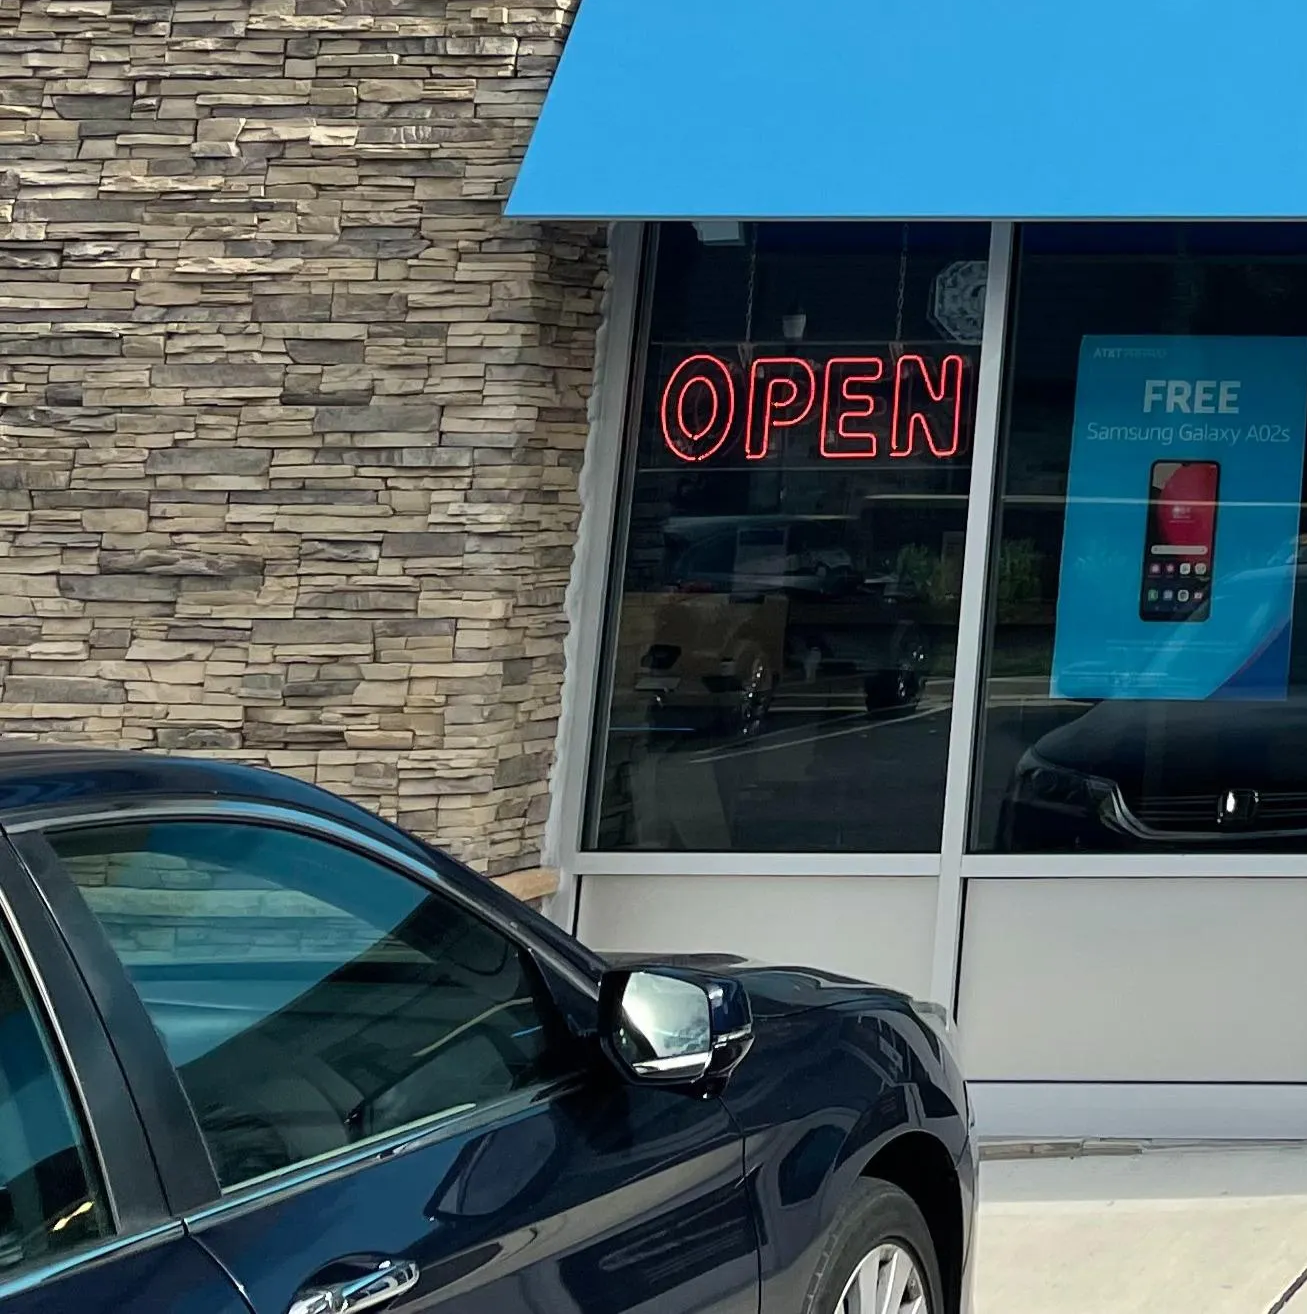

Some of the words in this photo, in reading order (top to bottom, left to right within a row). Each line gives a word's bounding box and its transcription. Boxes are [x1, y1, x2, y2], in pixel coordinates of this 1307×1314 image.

[661, 354, 963, 461] OPEN
[1143, 379, 1242, 414] FREE
[1086, 422, 1174, 446] Samsung
[1179, 423, 1241, 446] Galaxy
[1245, 424, 1291, 444] A02s
